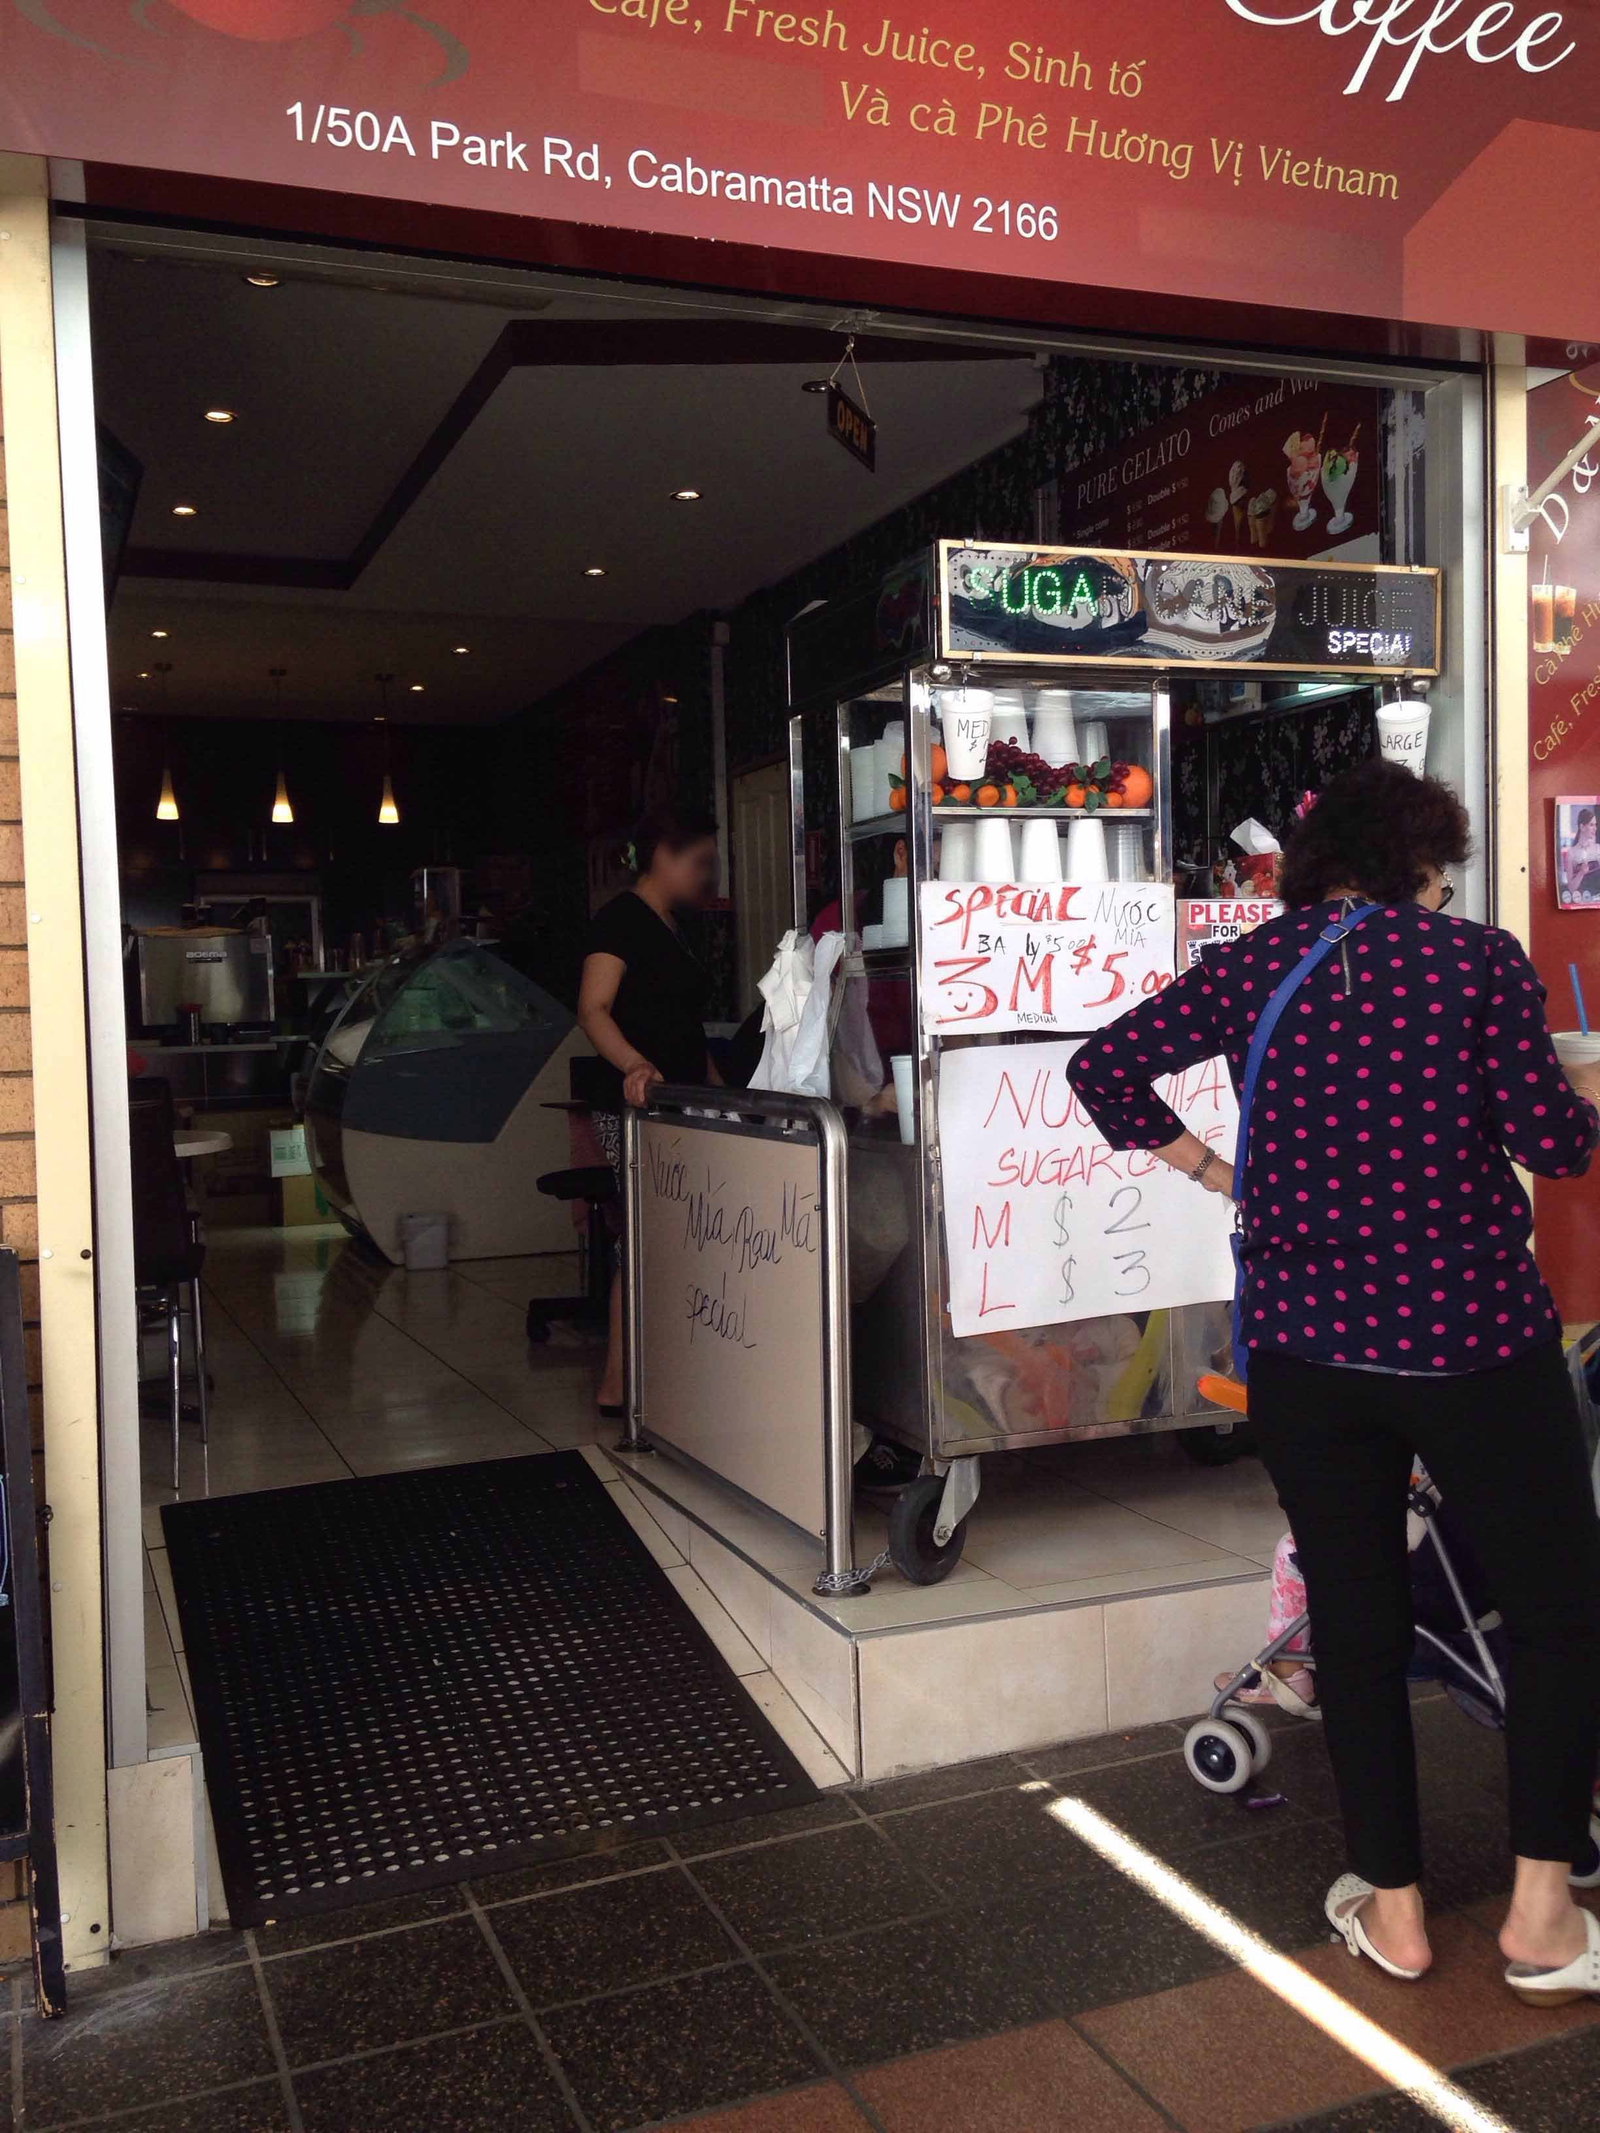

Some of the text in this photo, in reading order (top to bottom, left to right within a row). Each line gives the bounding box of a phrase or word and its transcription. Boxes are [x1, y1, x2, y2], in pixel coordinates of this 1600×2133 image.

[725, 0, 848, 51] Fresh
[863, 20, 987, 79] Juice,
[1004, 42, 1093, 91] Sinh
[1108, 60, 1147, 98] tố
[286, 101, 1058, 241] 1/50A Park Rd, Cabramatta NSW 2166
[840, 81, 1400, 200] Và cà Phê Hương Vị Vietnam
[1208, 404, 1250, 438] Cones
[1254, 378, 1284, 416] and
[1077, 427, 1192, 510] PURE GELATO
[1298, 586, 1413, 631] JUICE
[1533, 714, 1574, 762] Café,
[1190, 903, 1274, 924] PLEASE
[1212, 925, 1239, 938] FOR
[972, 1186, 1151, 1250] M $ 2
[979, 1249, 1151, 1317] L $ 3
